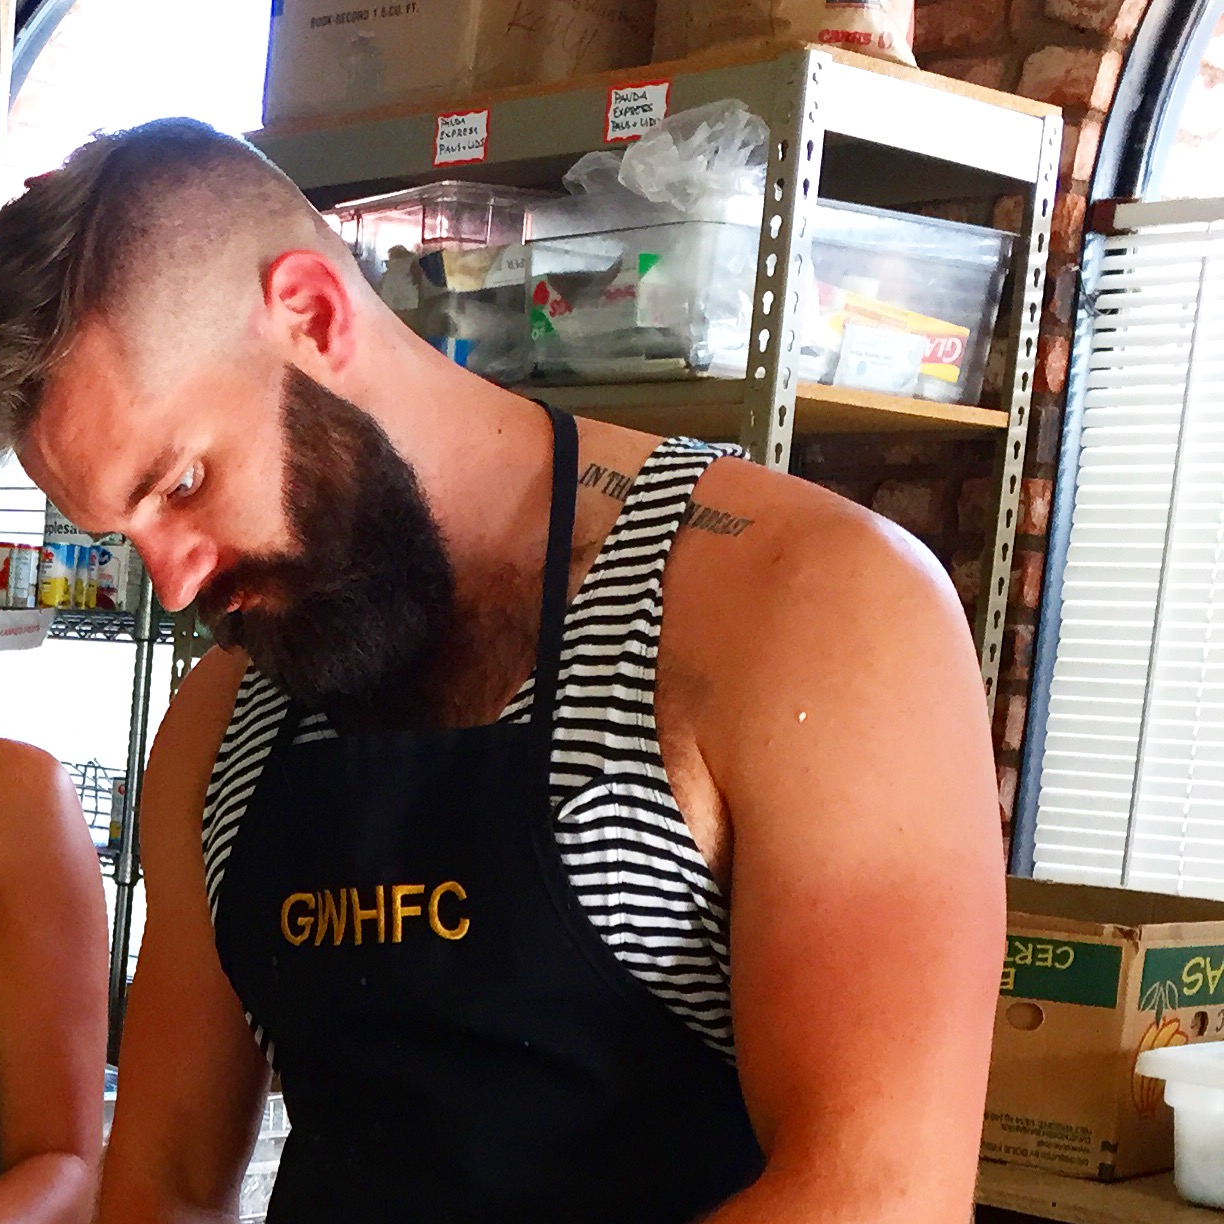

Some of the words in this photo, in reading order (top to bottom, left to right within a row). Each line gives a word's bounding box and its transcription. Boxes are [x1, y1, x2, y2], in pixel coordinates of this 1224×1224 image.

[614, 91, 648, 104] PANDA
[579, 463, 608, 489] IN
[601, 470, 636, 502] TH
[280, 880, 470, 946] GWHFC
